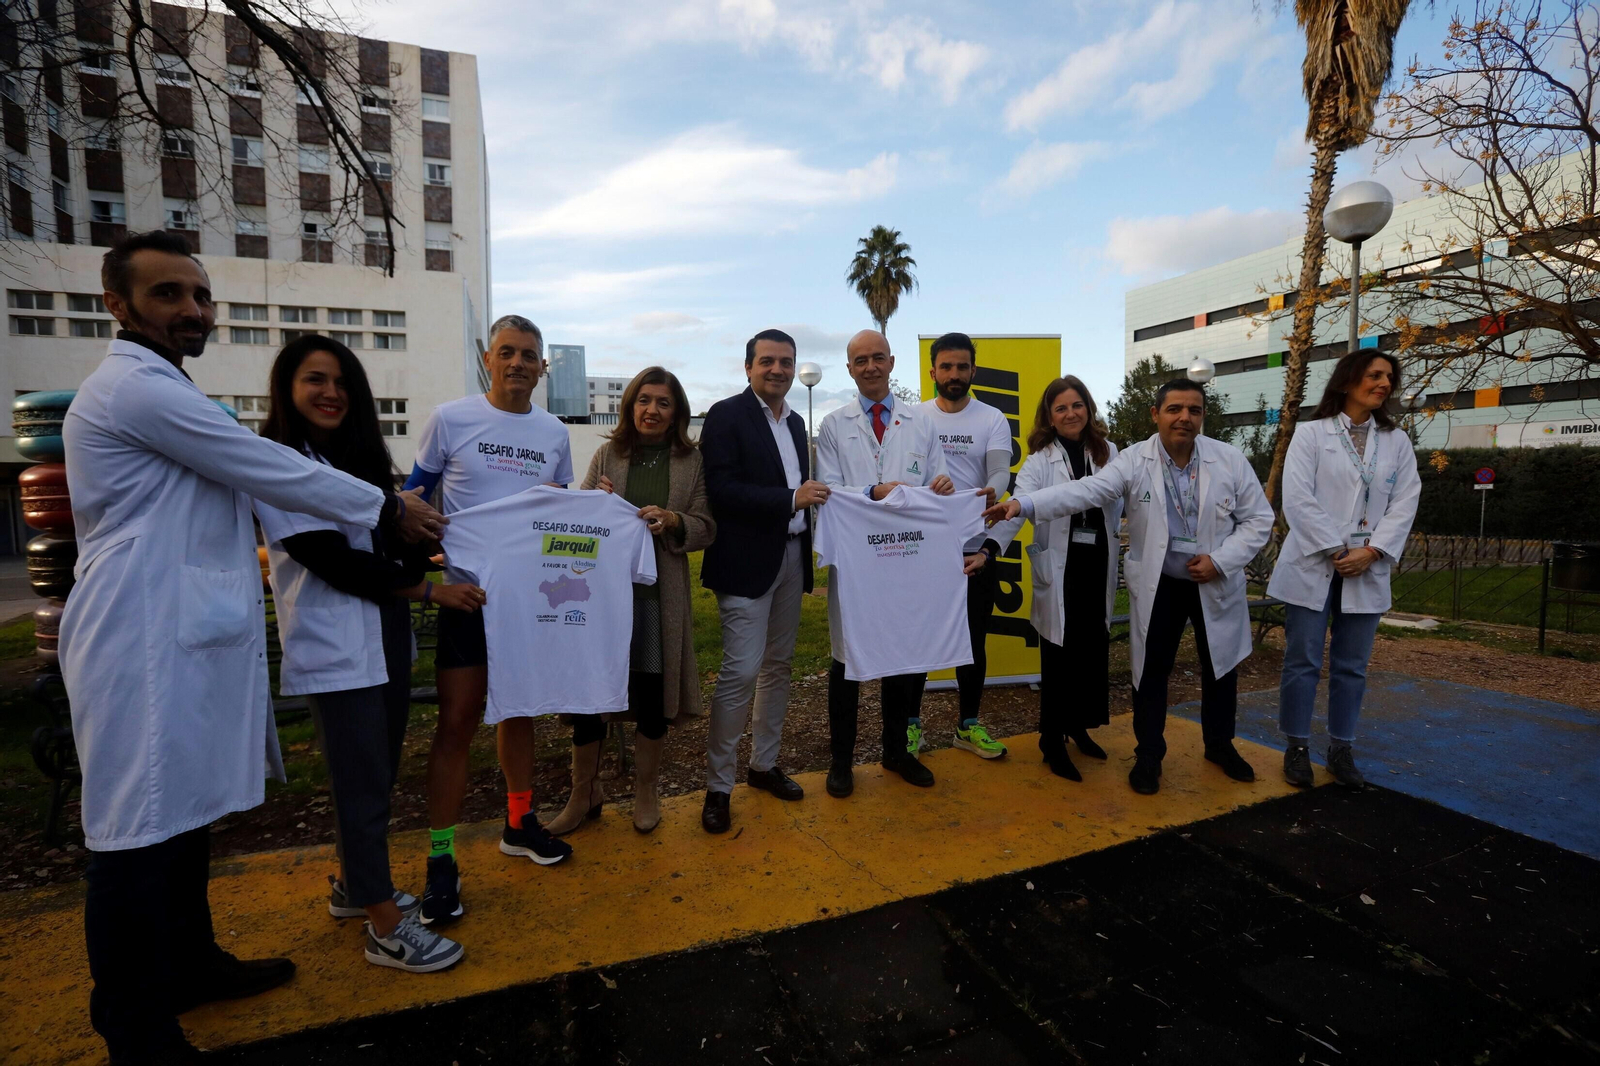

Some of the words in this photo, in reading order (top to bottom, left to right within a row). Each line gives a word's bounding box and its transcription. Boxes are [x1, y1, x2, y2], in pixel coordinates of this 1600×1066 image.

[1561, 424, 1600, 435] IMIBI
[949, 435, 974, 444] JARQUIL
[478, 442, 514, 458] DESAFIO
[515, 448, 546, 464] JARQUIL
[497, 458, 524, 467] sonrisa
[520, 469, 539, 477] pasos
[532, 521, 568, 533] DESAFIO
[570, 524, 610, 537] SOLIDARIO
[867, 533, 896, 545] DESAFIO
[897, 530, 924, 543] JARQUIL
[547, 537, 596, 554] jarquil
